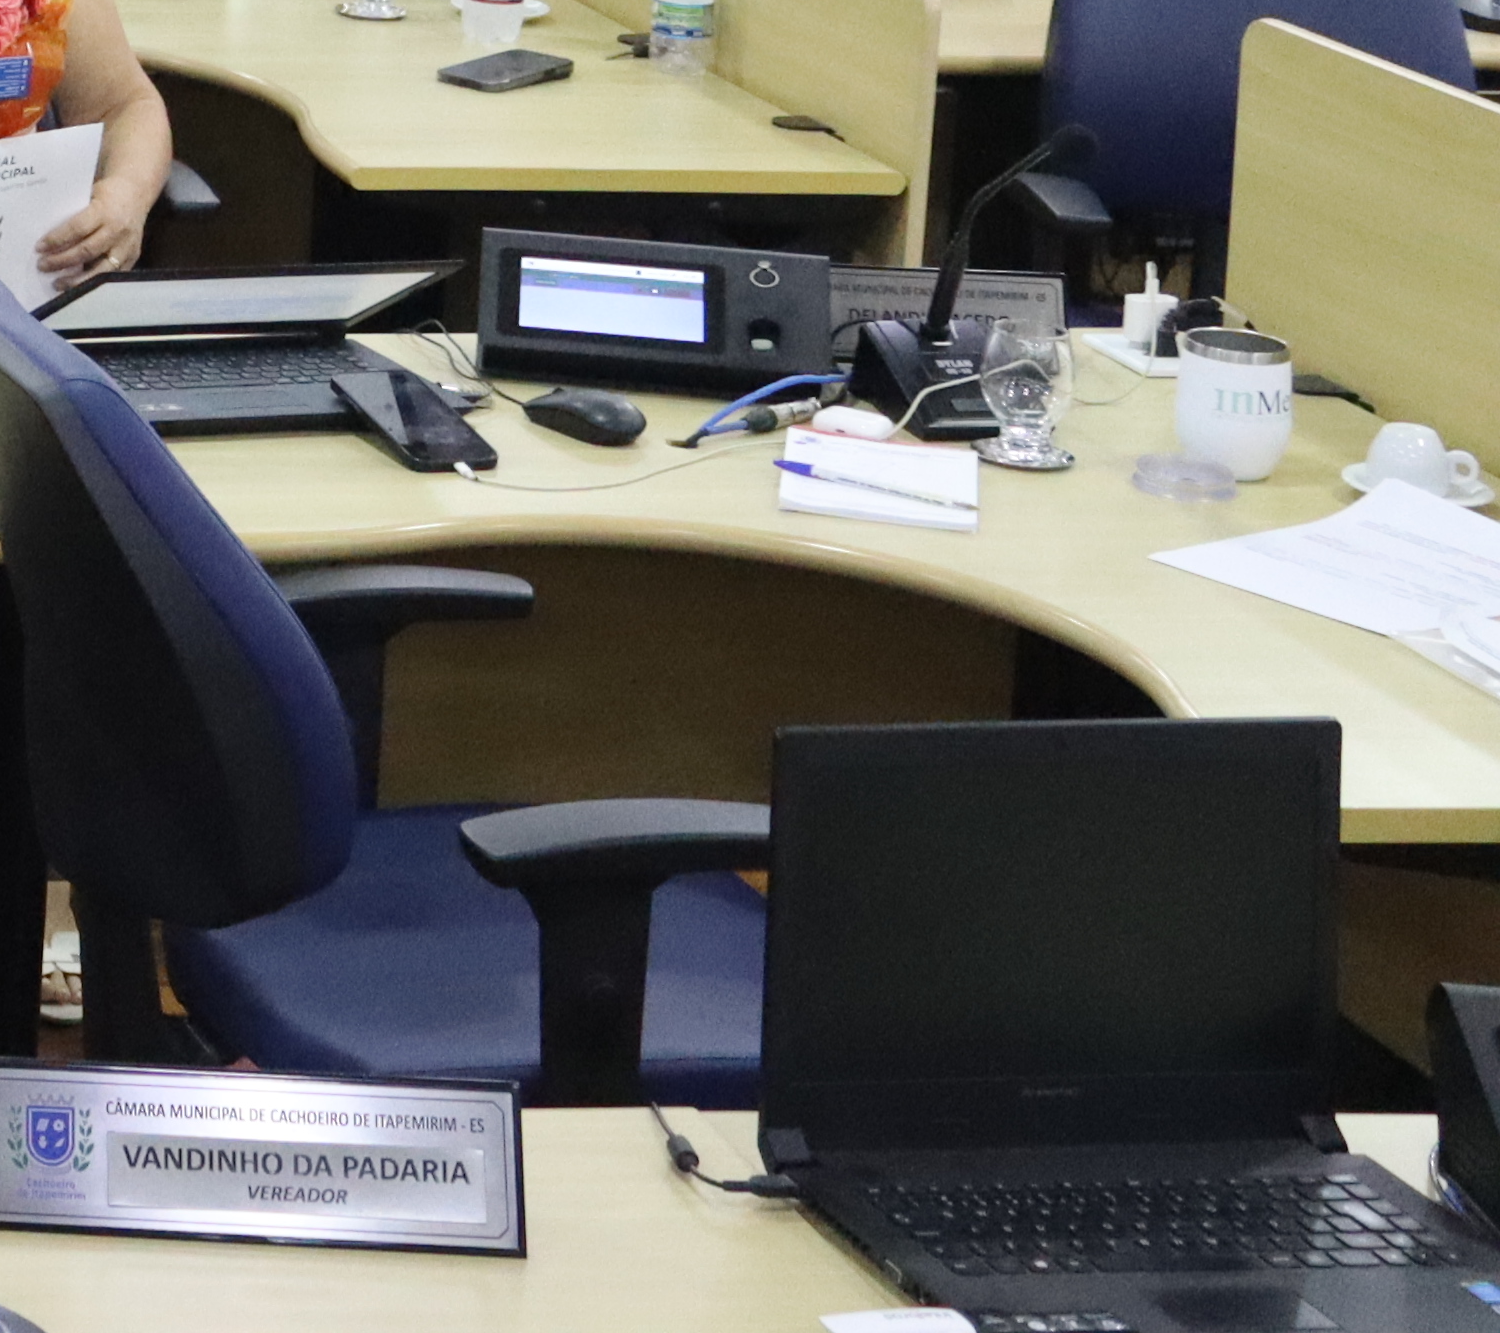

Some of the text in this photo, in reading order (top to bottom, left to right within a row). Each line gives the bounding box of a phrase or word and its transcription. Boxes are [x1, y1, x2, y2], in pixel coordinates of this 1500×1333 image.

[106, 1098, 486, 1133] CÂMARA MUNICIPAL DE CACHOEIRO DE ITAPEMIRIM ES
[122, 1144, 471, 1185] VANDINHO DA PADARIA
[246, 1185, 348, 1205] VEREADOR
